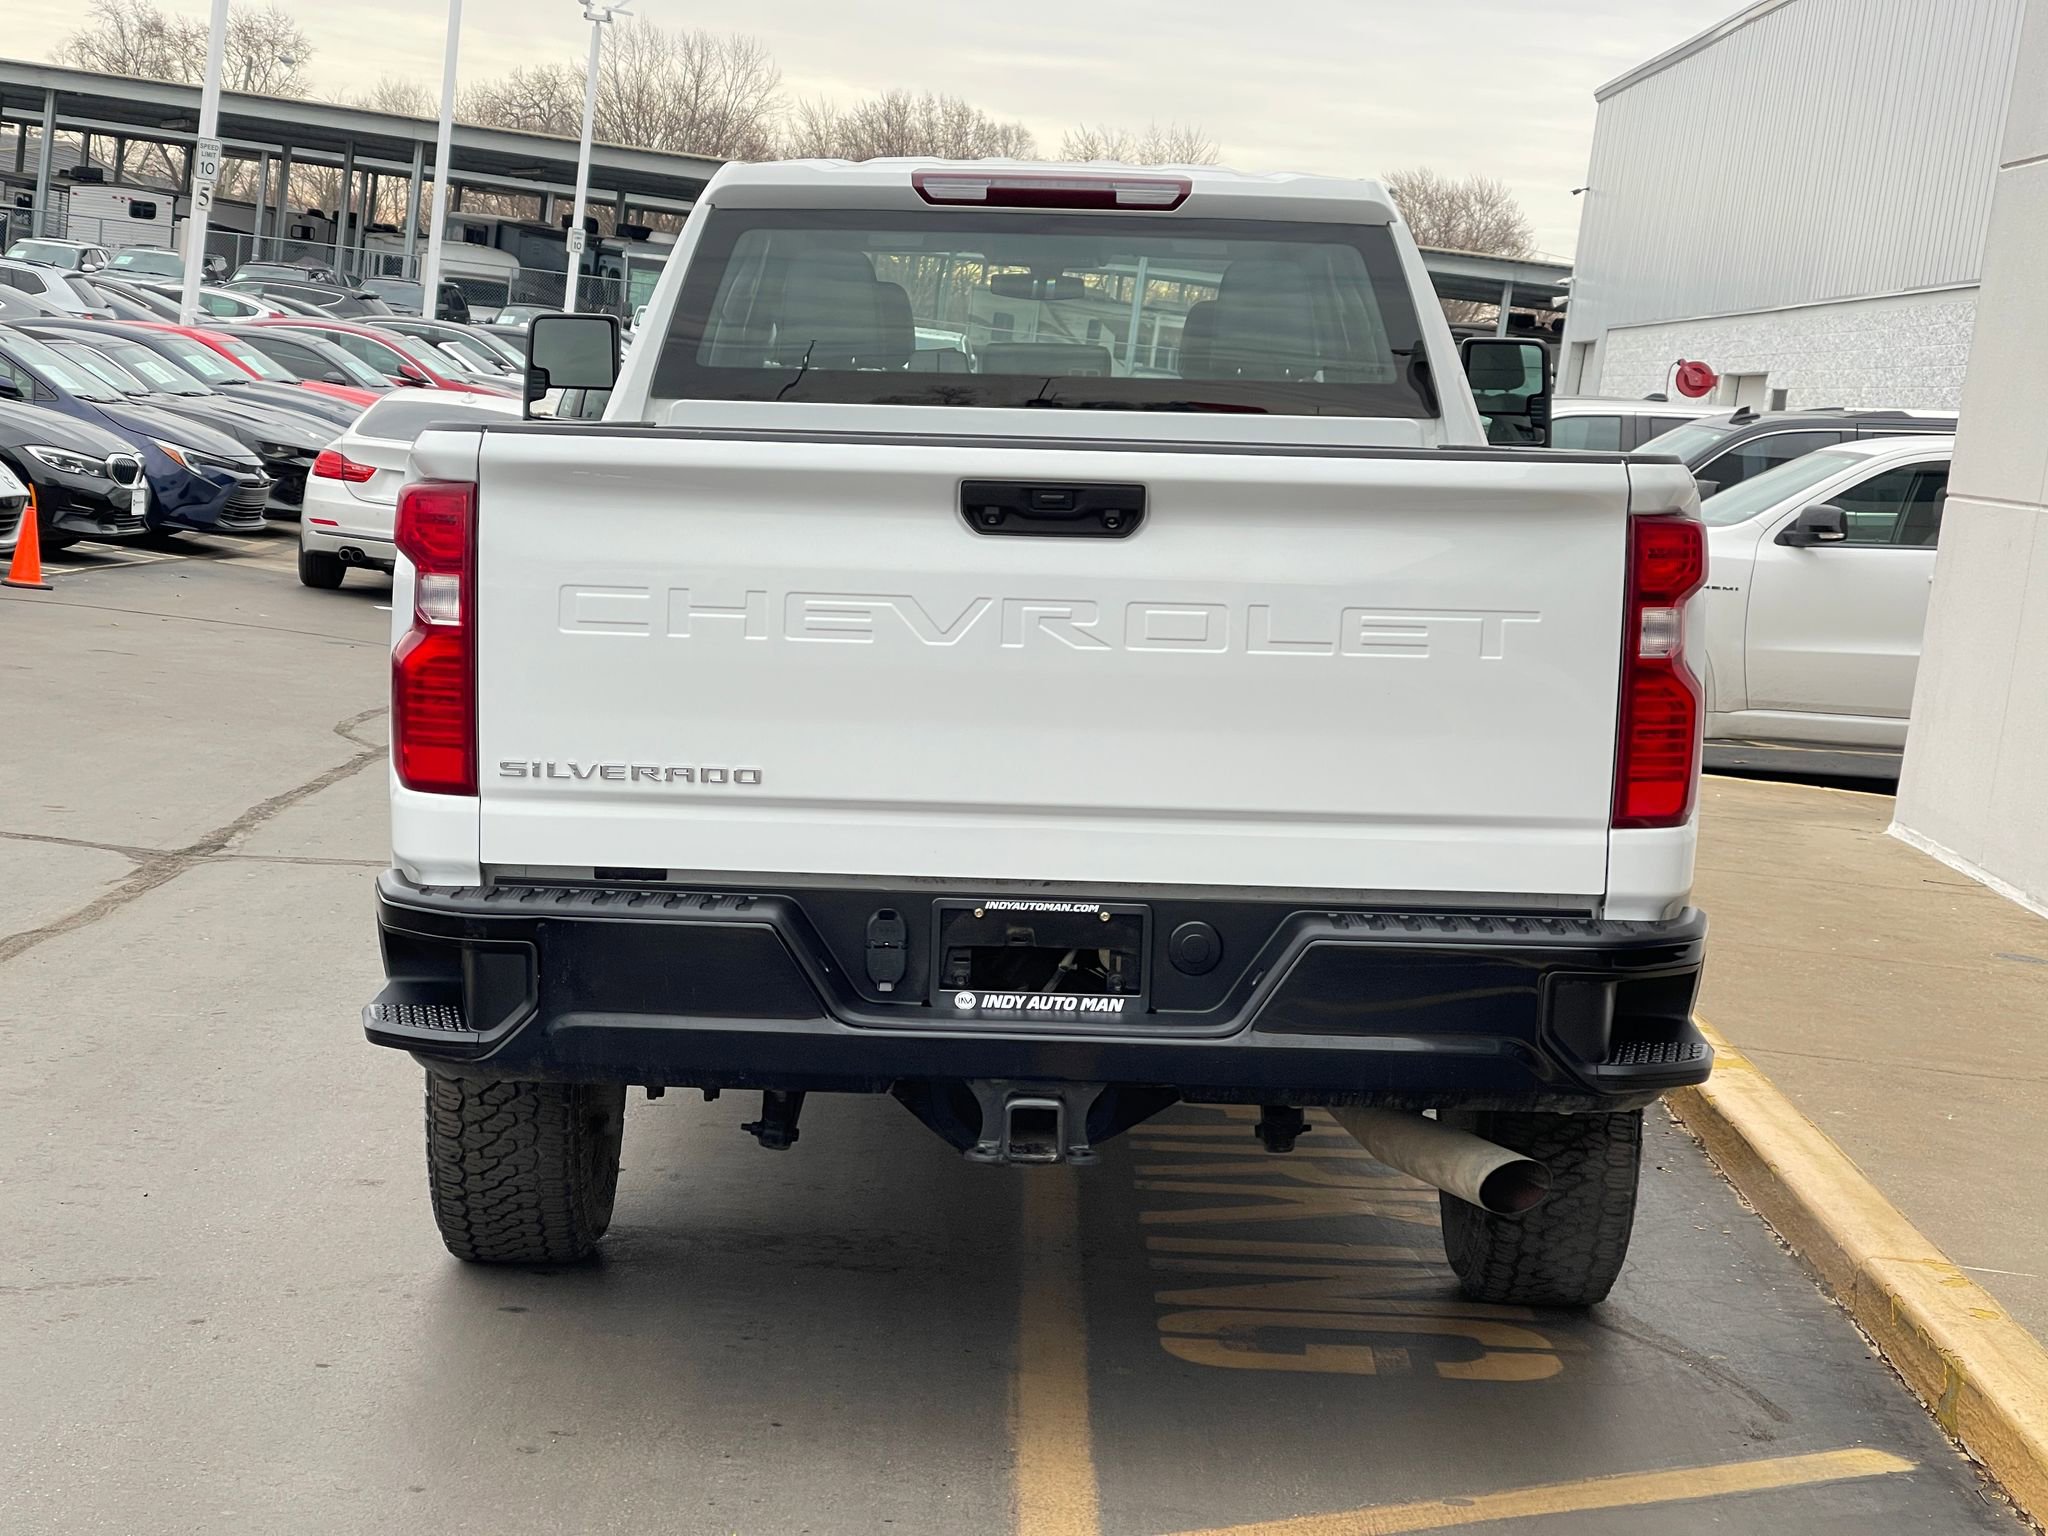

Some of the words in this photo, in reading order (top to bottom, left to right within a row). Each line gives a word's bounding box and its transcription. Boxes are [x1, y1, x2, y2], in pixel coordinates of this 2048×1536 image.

[200, 143, 218, 151] SPEED
[200, 161, 215, 175] 10
[198, 187, 210, 206] 5
[574, 242, 582, 250] 10
[558, 583, 1542, 661] CHEVROLET
[499, 760, 763, 785] SILVERADO
[984, 900, 1100, 913] INDYAUTOMAN.COM
[981, 994, 1027, 1011] INDY
[1026, 995, 1079, 1012] AUTO
[1079, 997, 1125, 1013] MAN
[1127, 1103, 1564, 1382] RKING
